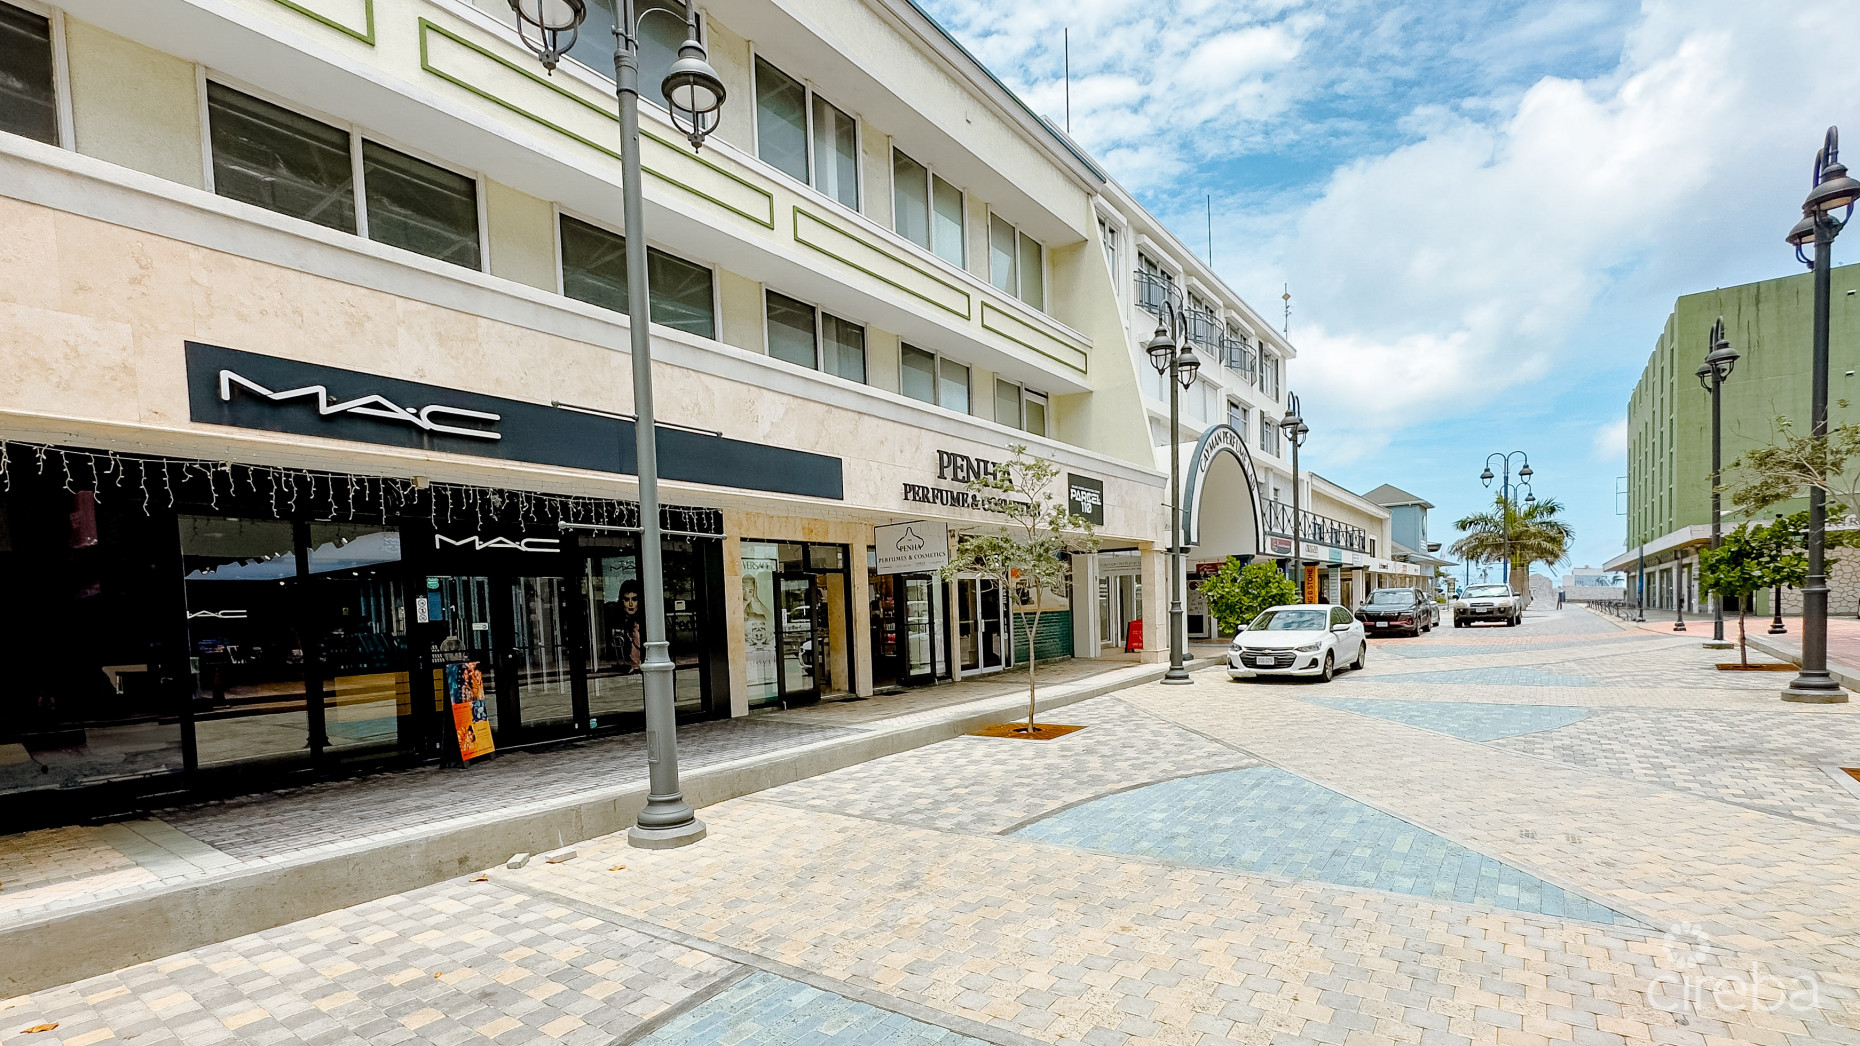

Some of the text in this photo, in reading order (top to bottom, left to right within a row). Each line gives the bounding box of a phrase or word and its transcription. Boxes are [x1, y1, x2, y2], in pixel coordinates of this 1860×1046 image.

[1200, 430, 1223, 473] CAYMAN
[903, 482, 970, 508] PERFUME
[970, 493, 981, 510] &
[1070, 488, 1102, 506] PARCEL
[878, 555, 907, 563] PERFUMES
[914, 551, 946, 560] COSMETICS
[899, 543, 923, 553] PENHA
